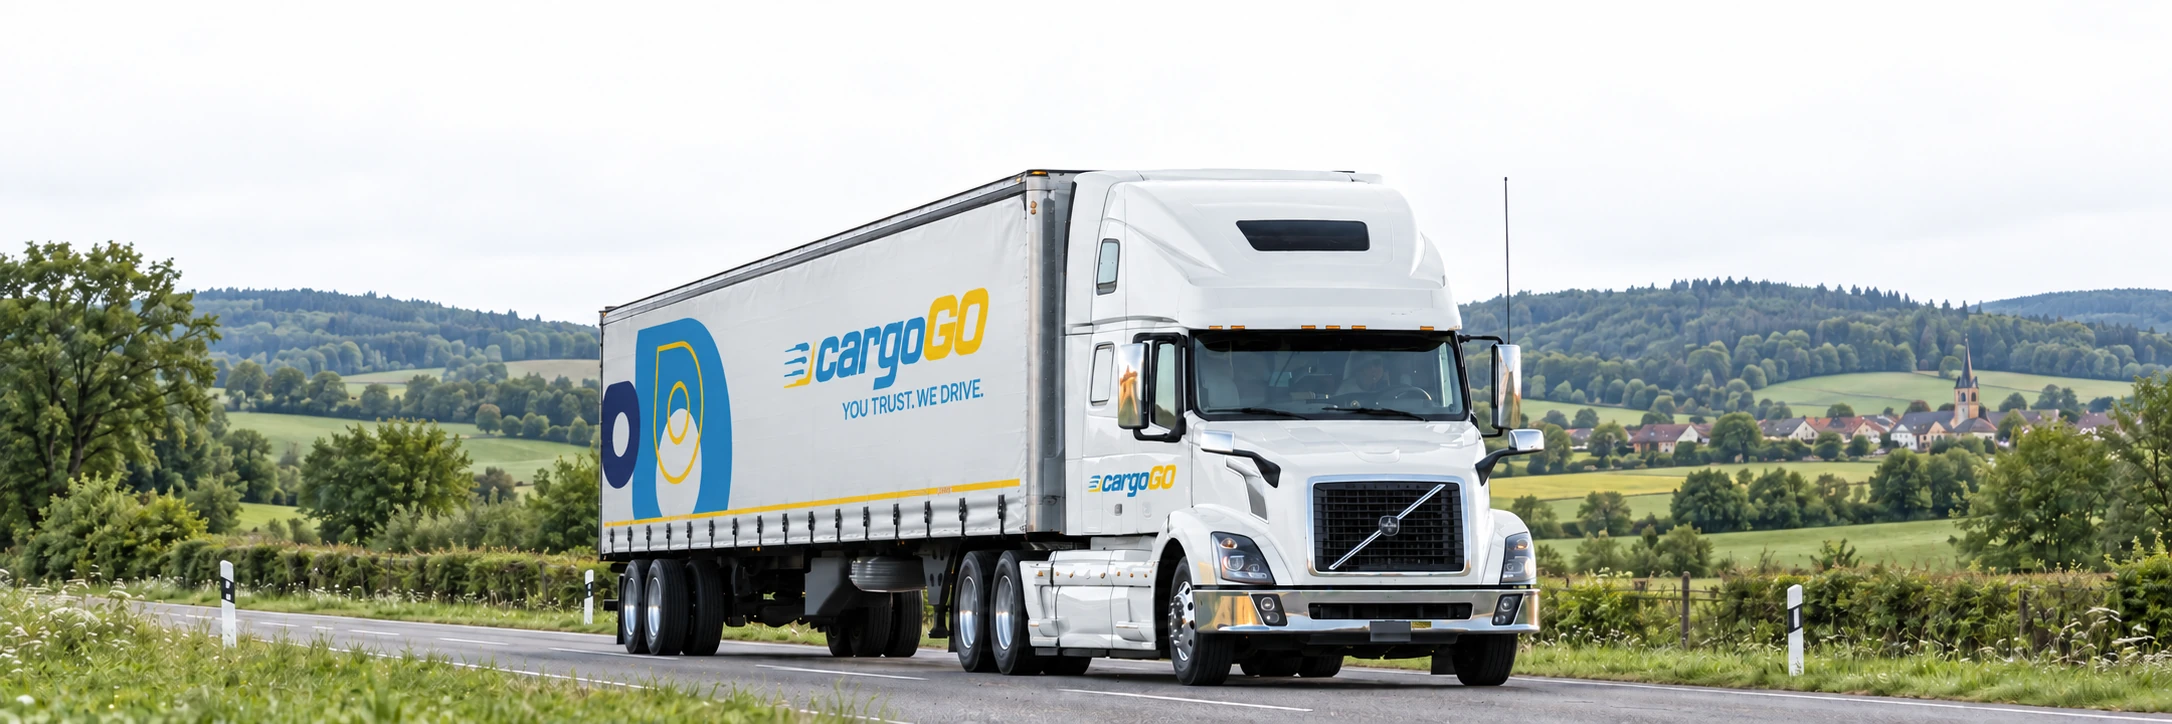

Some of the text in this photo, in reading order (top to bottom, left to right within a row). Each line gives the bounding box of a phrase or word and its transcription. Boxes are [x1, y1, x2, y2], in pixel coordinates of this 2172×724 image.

[815, 287, 990, 391] cargoGO
[842, 378, 984, 420] YOU TRUST. WE DRIVE.
[1101, 463, 1177, 498] cargoGO
